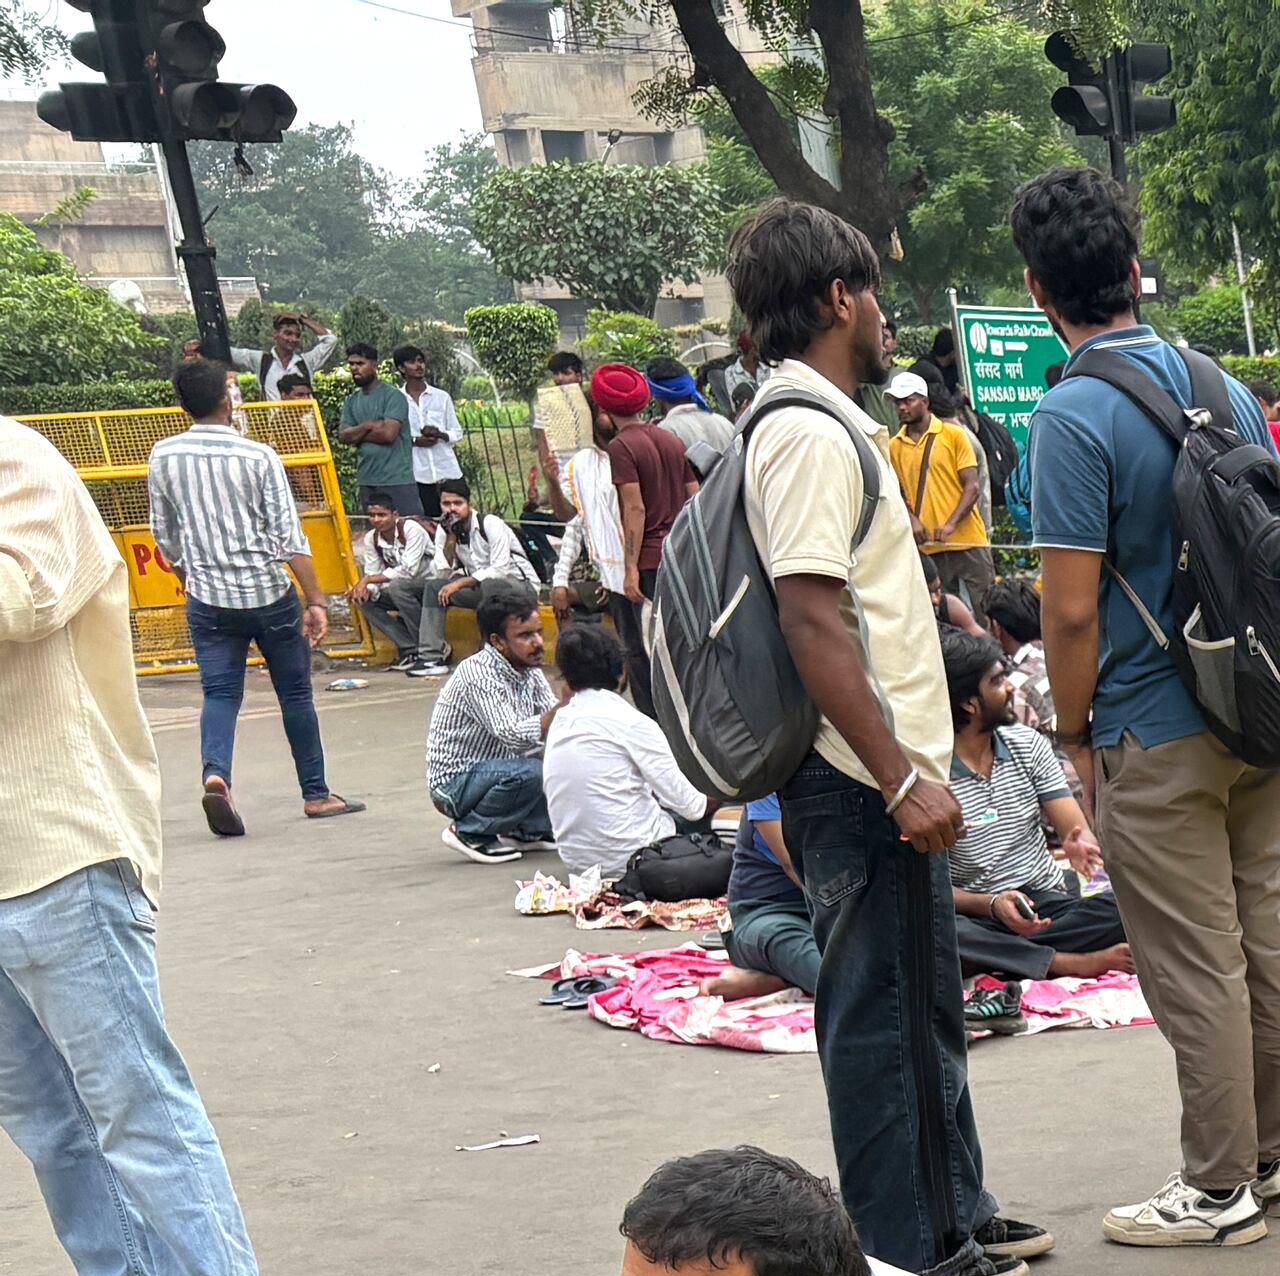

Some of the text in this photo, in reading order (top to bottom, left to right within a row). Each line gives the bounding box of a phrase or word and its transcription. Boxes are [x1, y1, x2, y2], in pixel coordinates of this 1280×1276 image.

[974, 356, 1024, 379] संसद मार्ग
[977, 386, 1044, 402] SANSAD MARG
